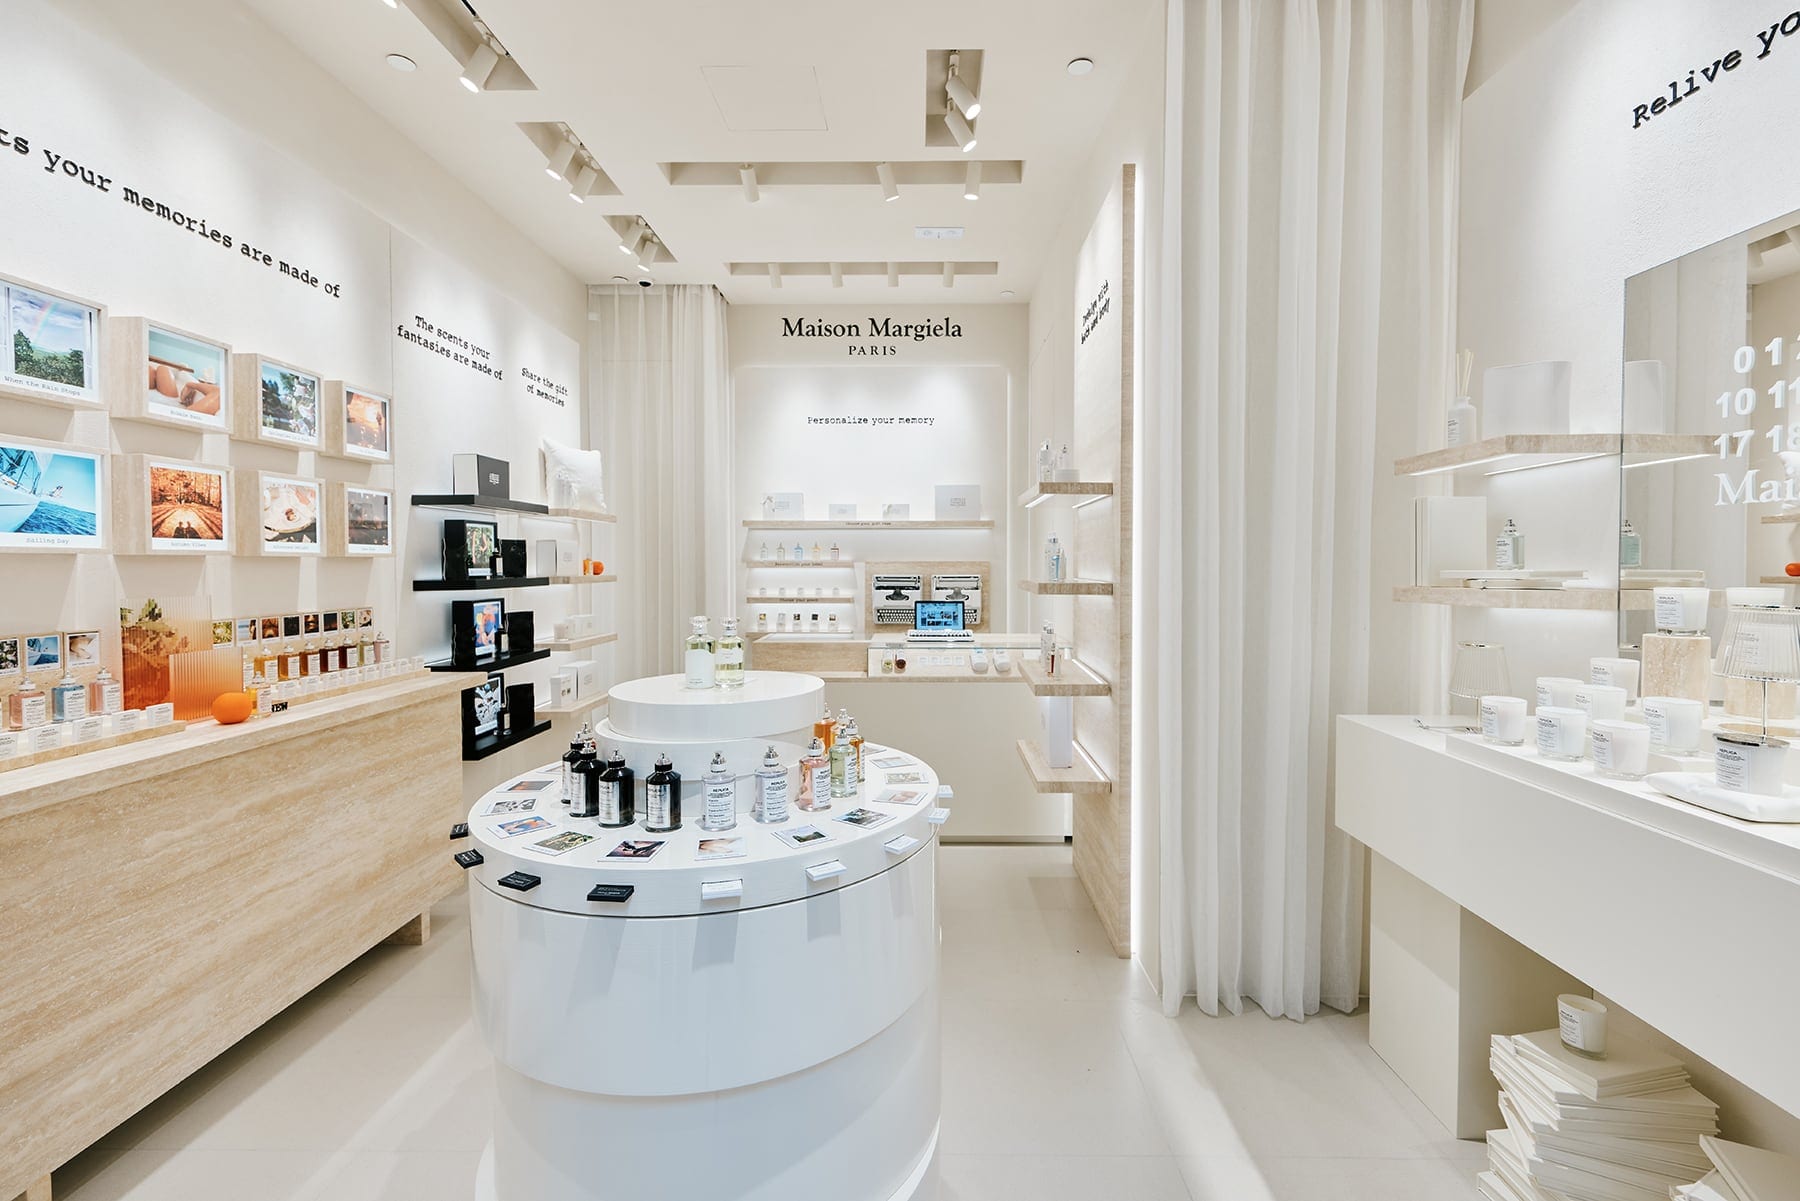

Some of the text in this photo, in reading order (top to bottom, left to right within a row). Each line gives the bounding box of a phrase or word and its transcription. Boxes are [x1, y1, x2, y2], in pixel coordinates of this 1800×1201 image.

[1632, 49, 1742, 129] Relive
[43, 149, 112, 193] your
[122, 185, 233, 249] memories
[240, 240, 273, 266] are
[279, 259, 319, 288] made
[324, 281, 341, 299] of
[415, 315, 490, 360] The scents your
[781, 317, 963, 342] Maison Margiela
[397, 325, 503, 381] fantasies are made of
[848, 345, 897, 356] PARIS
[521, 367, 569, 397] Share the gift
[526, 384, 565, 408] of memories
[1716, 388, 1757, 418] 10
[807, 416, 935, 426] Personalize your memory
[1714, 429, 1755, 460] 17
[1714, 469, 1800, 506] Mai
